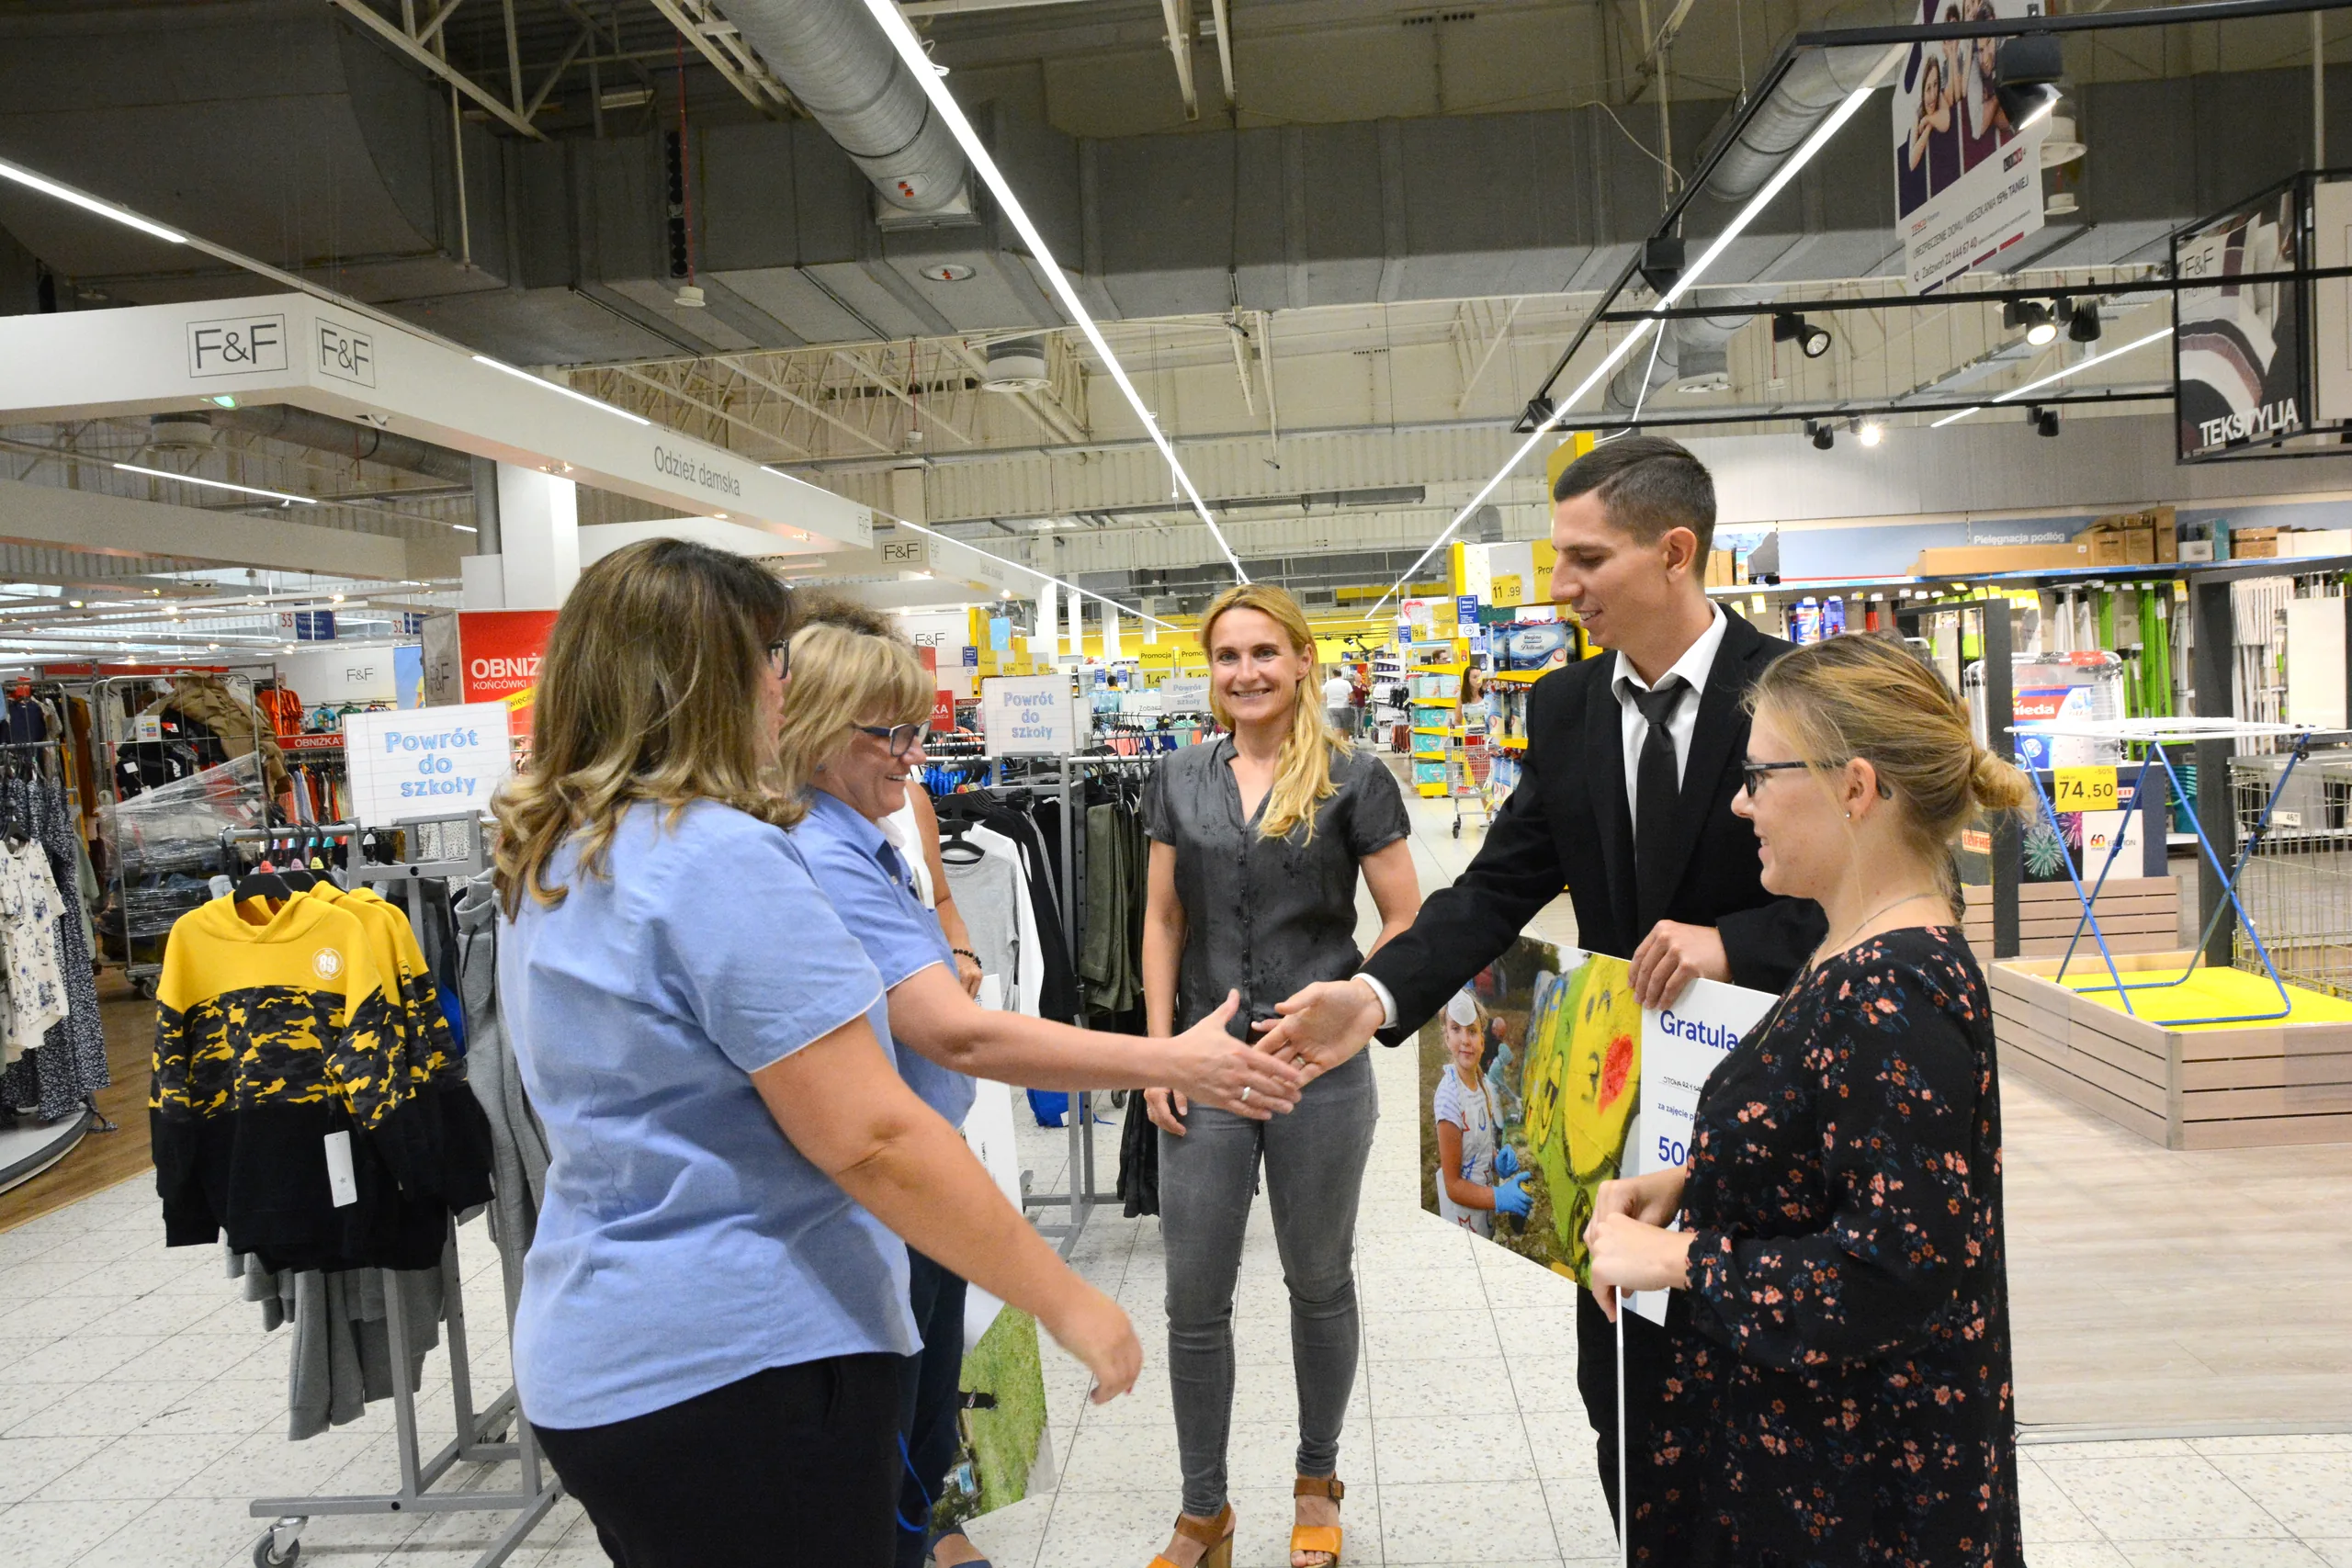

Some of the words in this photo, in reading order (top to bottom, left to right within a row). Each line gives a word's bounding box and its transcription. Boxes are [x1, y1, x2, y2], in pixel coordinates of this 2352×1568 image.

[2008, 175, 2030, 197] TANIEJ
[195, 323, 277, 369] F&F
[322, 328, 369, 376] F&F
[2199, 398, 2299, 447] TEKSTYLIA
[654, 446, 696, 483] Odzież
[698, 463, 741, 497] damska
[1973, 534, 2029, 546] Pielęgnacja
[2031, 532, 2065, 544] podłóg
[884, 543, 919, 560] F&F
[281, 613, 293, 627] 33
[393, 620, 403, 634] 32
[915, 632, 945, 647] F&F
[1140, 649, 1172, 660] Promocja
[346, 668, 374, 682] F&F
[472, 678, 526, 691] KOŃCÓWKI
[1003, 691, 1054, 707] Powrót
[1022, 708, 1040, 724] do
[384, 728, 479, 752] Powrót
[1012, 726, 1053, 740] szkoły
[294, 737, 340, 749] OBNIŻKA
[419, 754, 453, 775] do
[401, 776, 476, 797] szkoły
[2090, 833, 2106, 847] 60
[319, 953, 338, 974] 89
[1657, 1102, 1666, 1111] za
[1666, 1105, 1689, 1118] zajęcie
